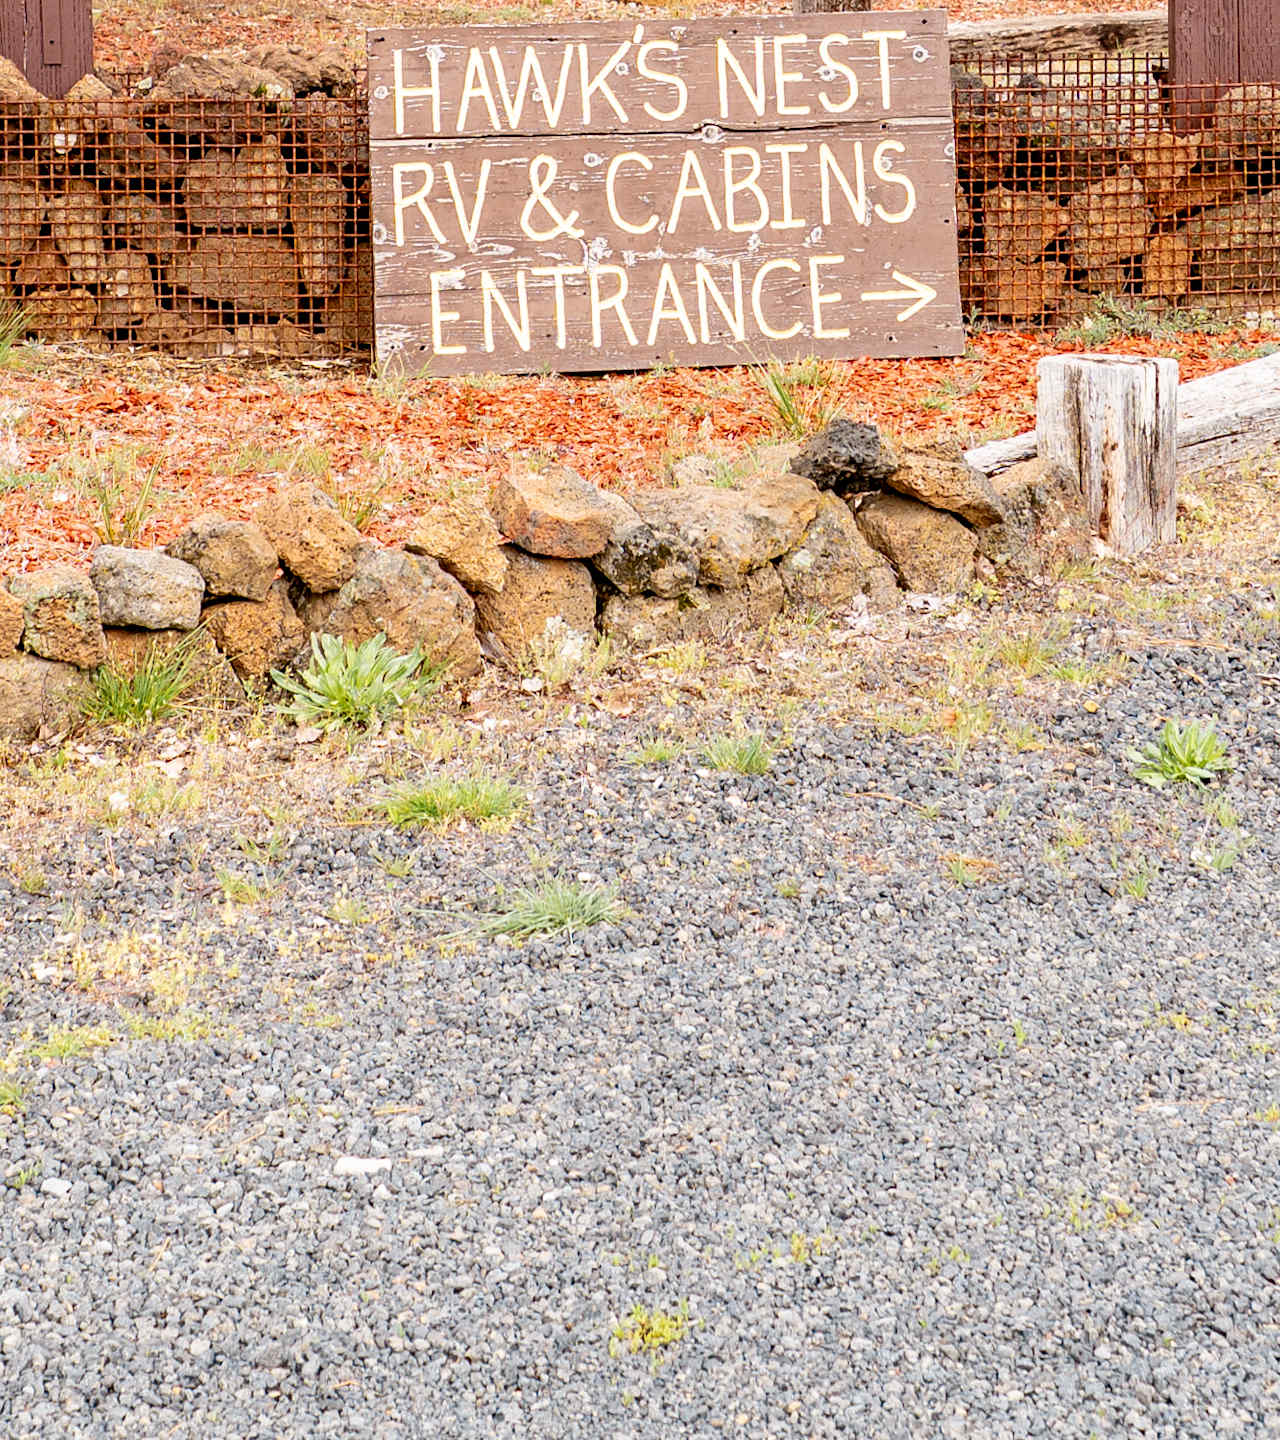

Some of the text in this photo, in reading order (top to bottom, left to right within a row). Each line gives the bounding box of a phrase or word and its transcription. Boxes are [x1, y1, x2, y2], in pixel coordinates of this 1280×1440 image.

[392, 23, 906, 134] HAWK'S NEST
[391, 139, 917, 248] RV & CABINS
[429, 255, 851, 355] ENTRANCE
